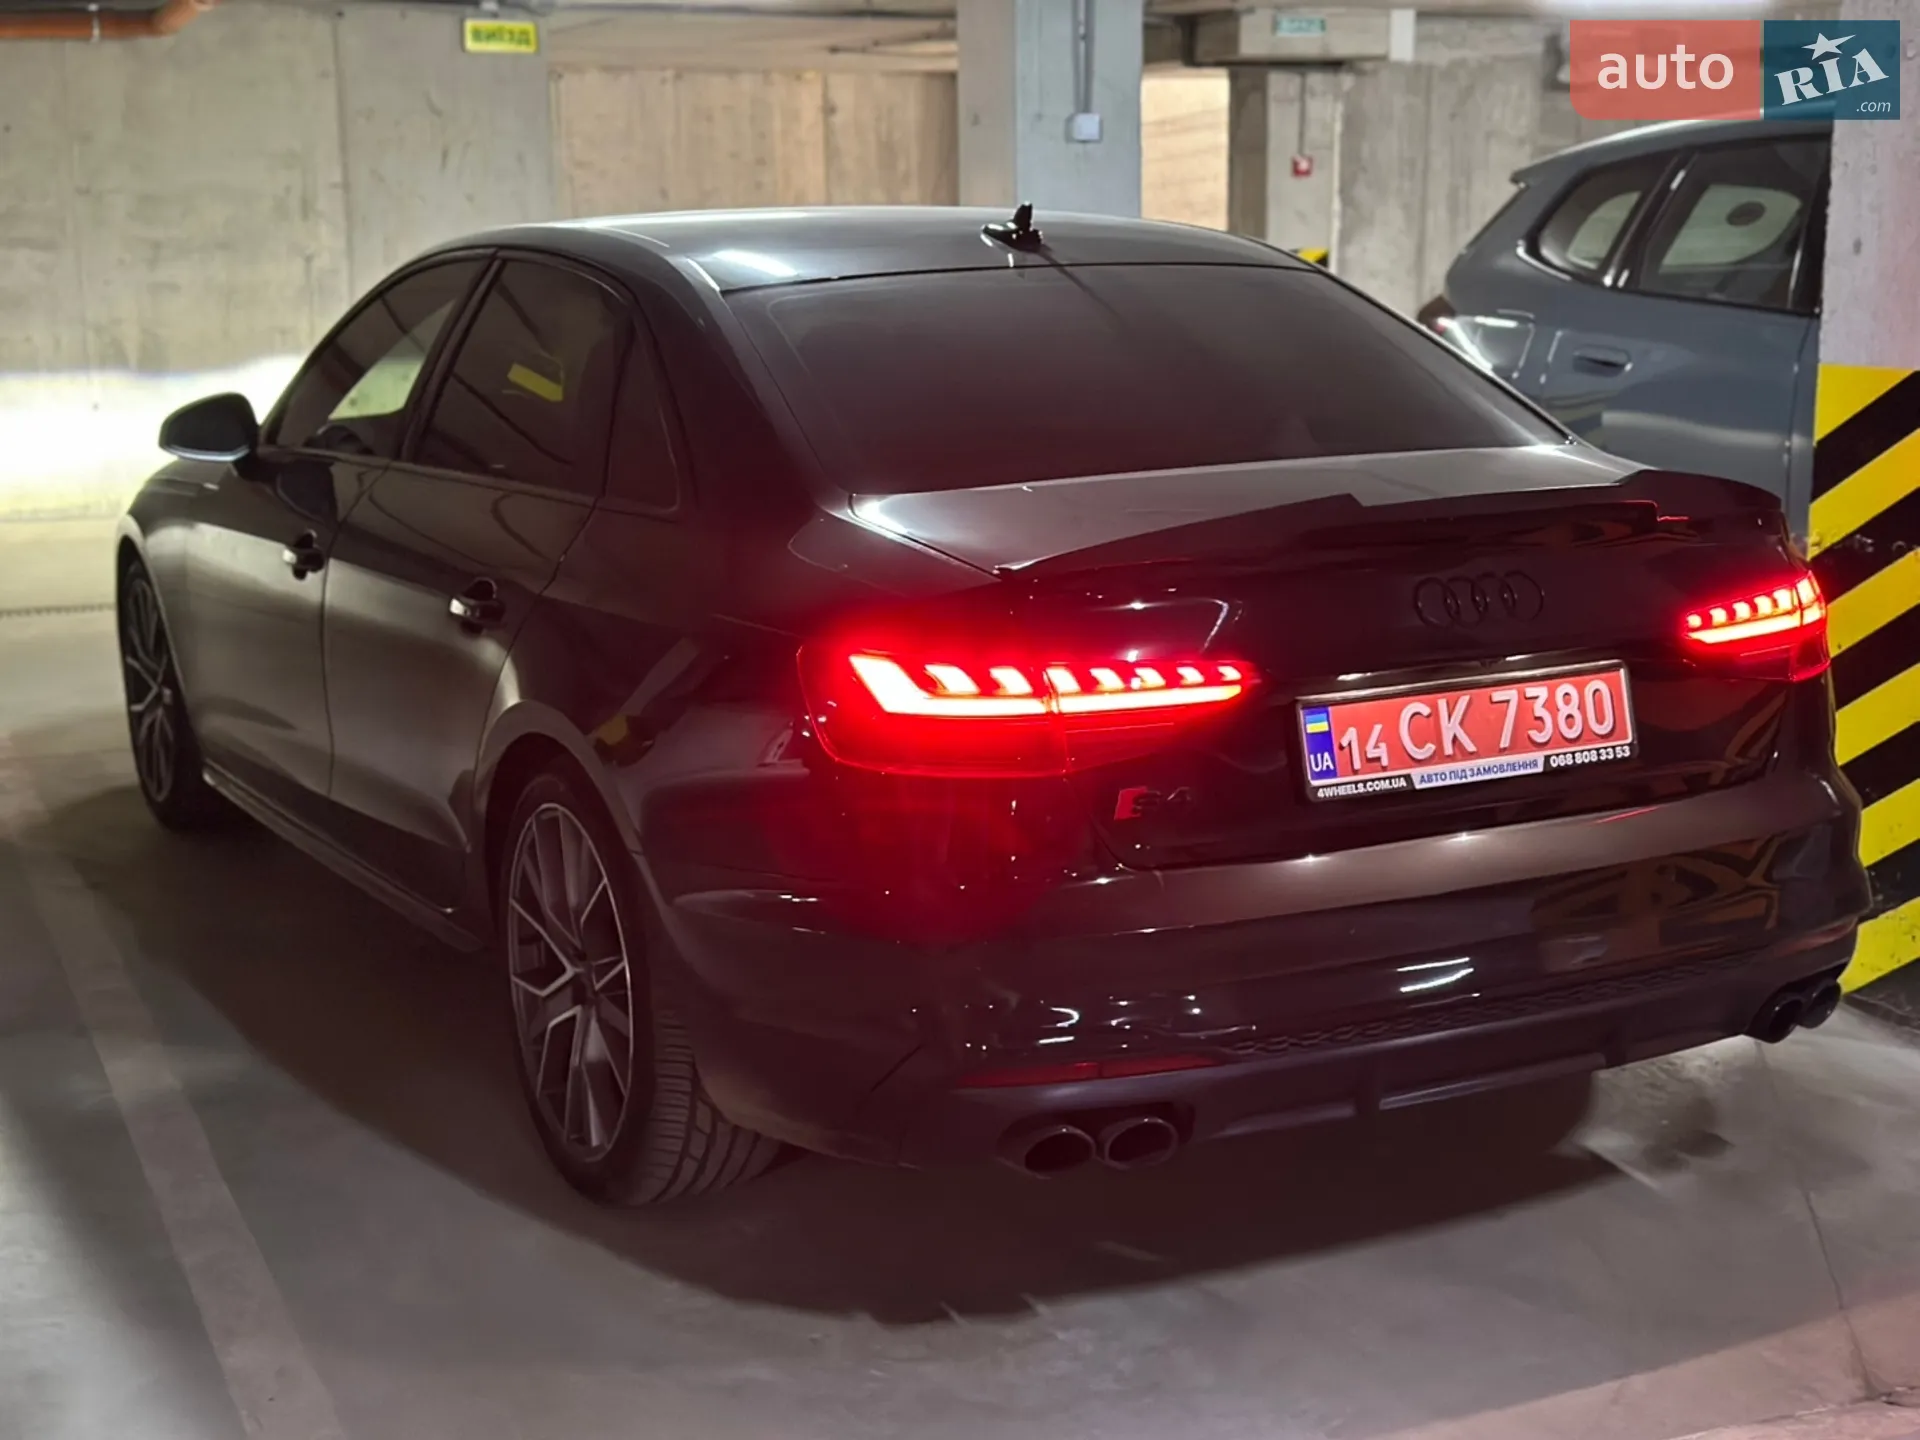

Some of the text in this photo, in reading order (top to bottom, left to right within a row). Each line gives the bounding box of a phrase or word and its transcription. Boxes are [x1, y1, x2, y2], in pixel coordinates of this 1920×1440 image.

[1340, 679, 1614, 771] 14 CK 7380
[1310, 751, 1334, 772] UA
[1550, 745, 1631, 767] 068 808 33 53
[1419, 759, 1539, 785] АВТО ПІД ЗАМОВЛЕННЯ
[1317, 777, 1407, 798] 4WHEELS.COM.UA
